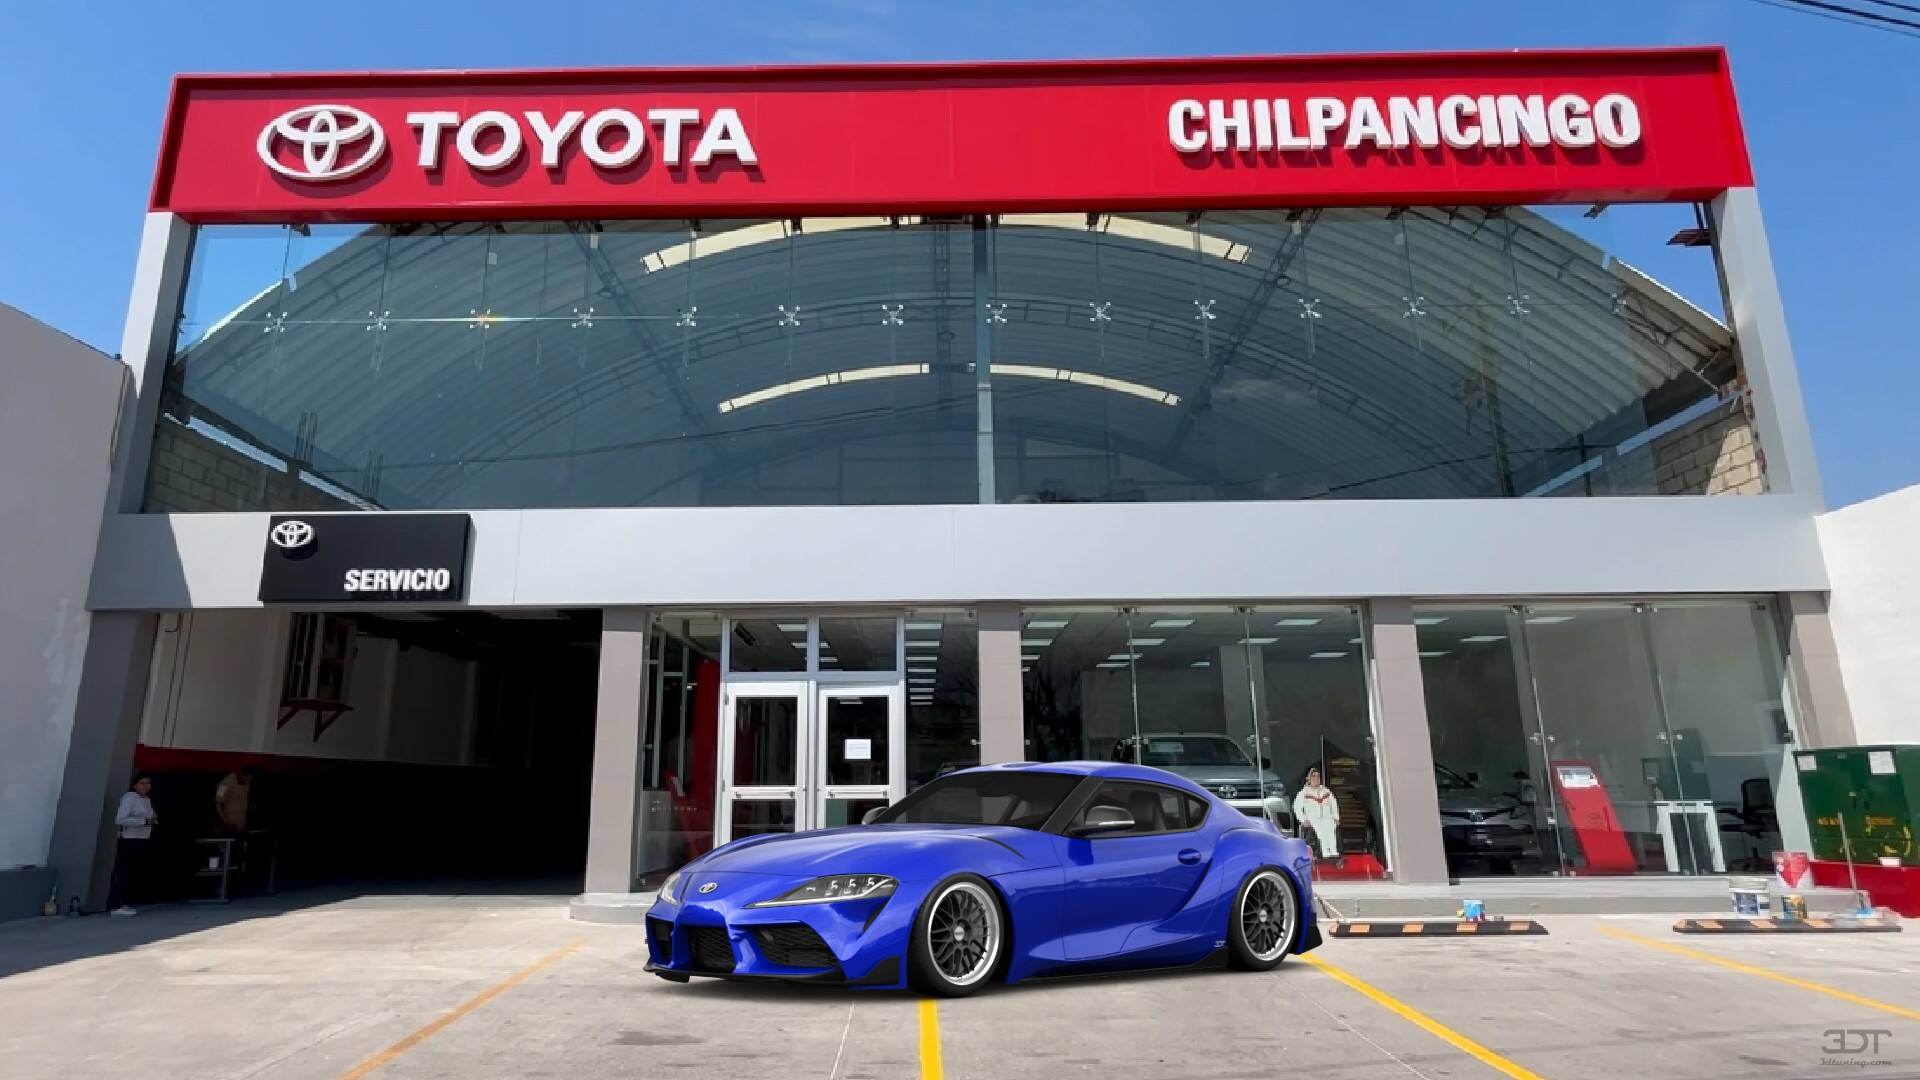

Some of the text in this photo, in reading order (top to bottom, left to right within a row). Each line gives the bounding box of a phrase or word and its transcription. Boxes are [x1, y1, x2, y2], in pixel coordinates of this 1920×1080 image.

[406, 108, 758, 169] TOYOTA
[1168, 93, 1641, 153] CHILPANCINGO
[344, 568, 450, 591] SERVICIO
